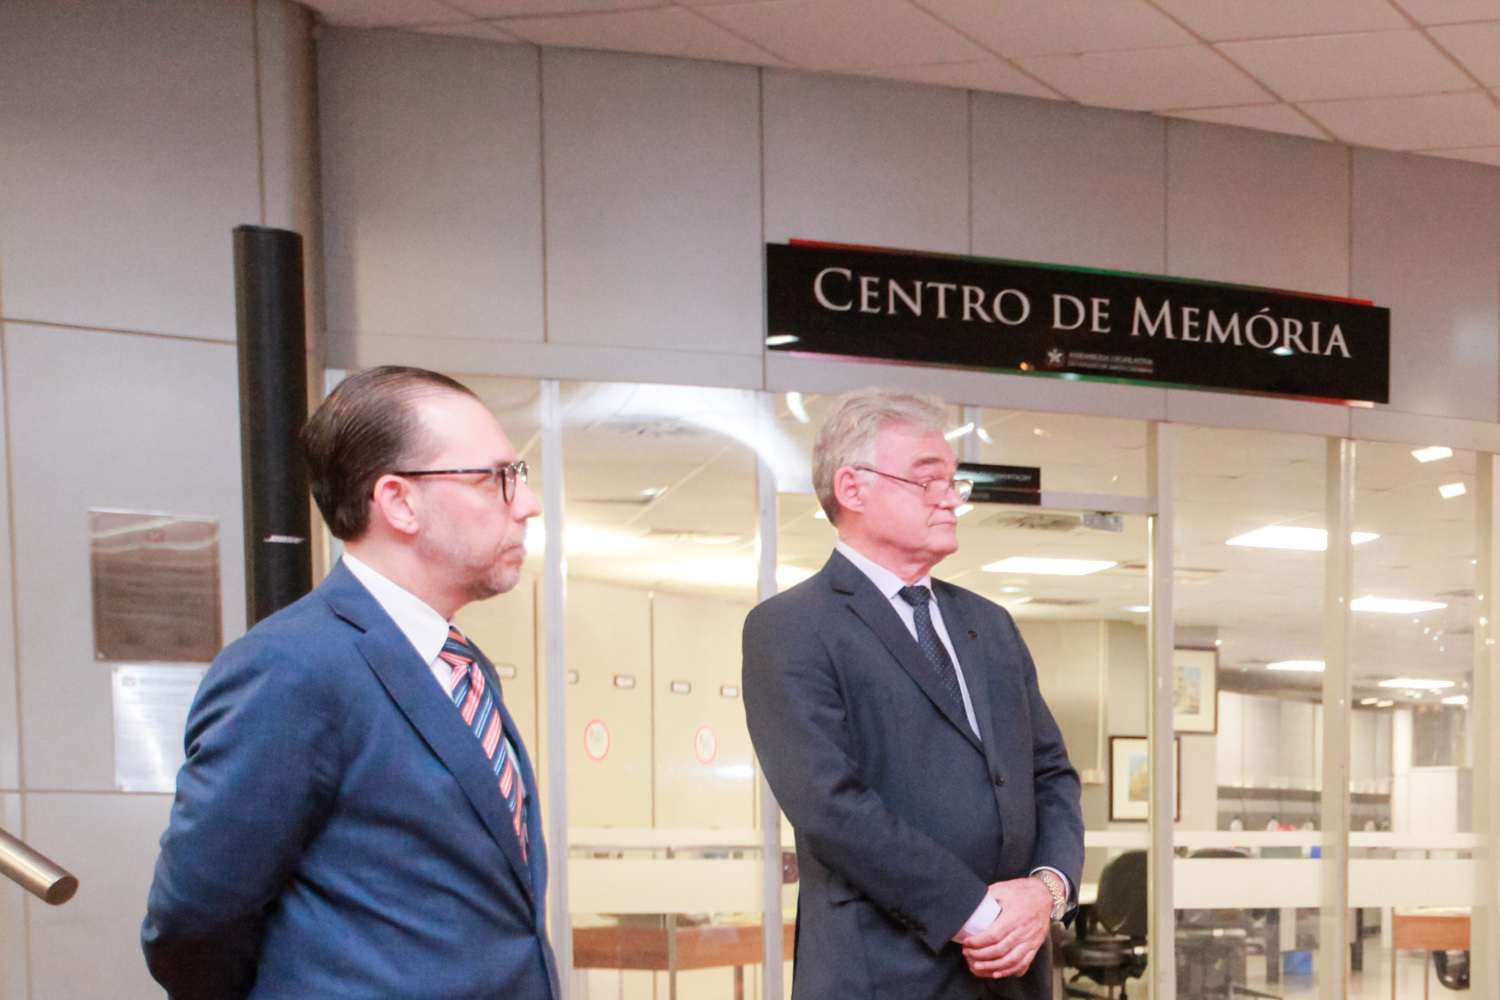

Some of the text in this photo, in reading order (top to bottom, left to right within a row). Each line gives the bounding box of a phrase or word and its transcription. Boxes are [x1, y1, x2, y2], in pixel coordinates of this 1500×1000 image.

[813, 266, 1352, 359] CENTRO DE MEMÓRIA
